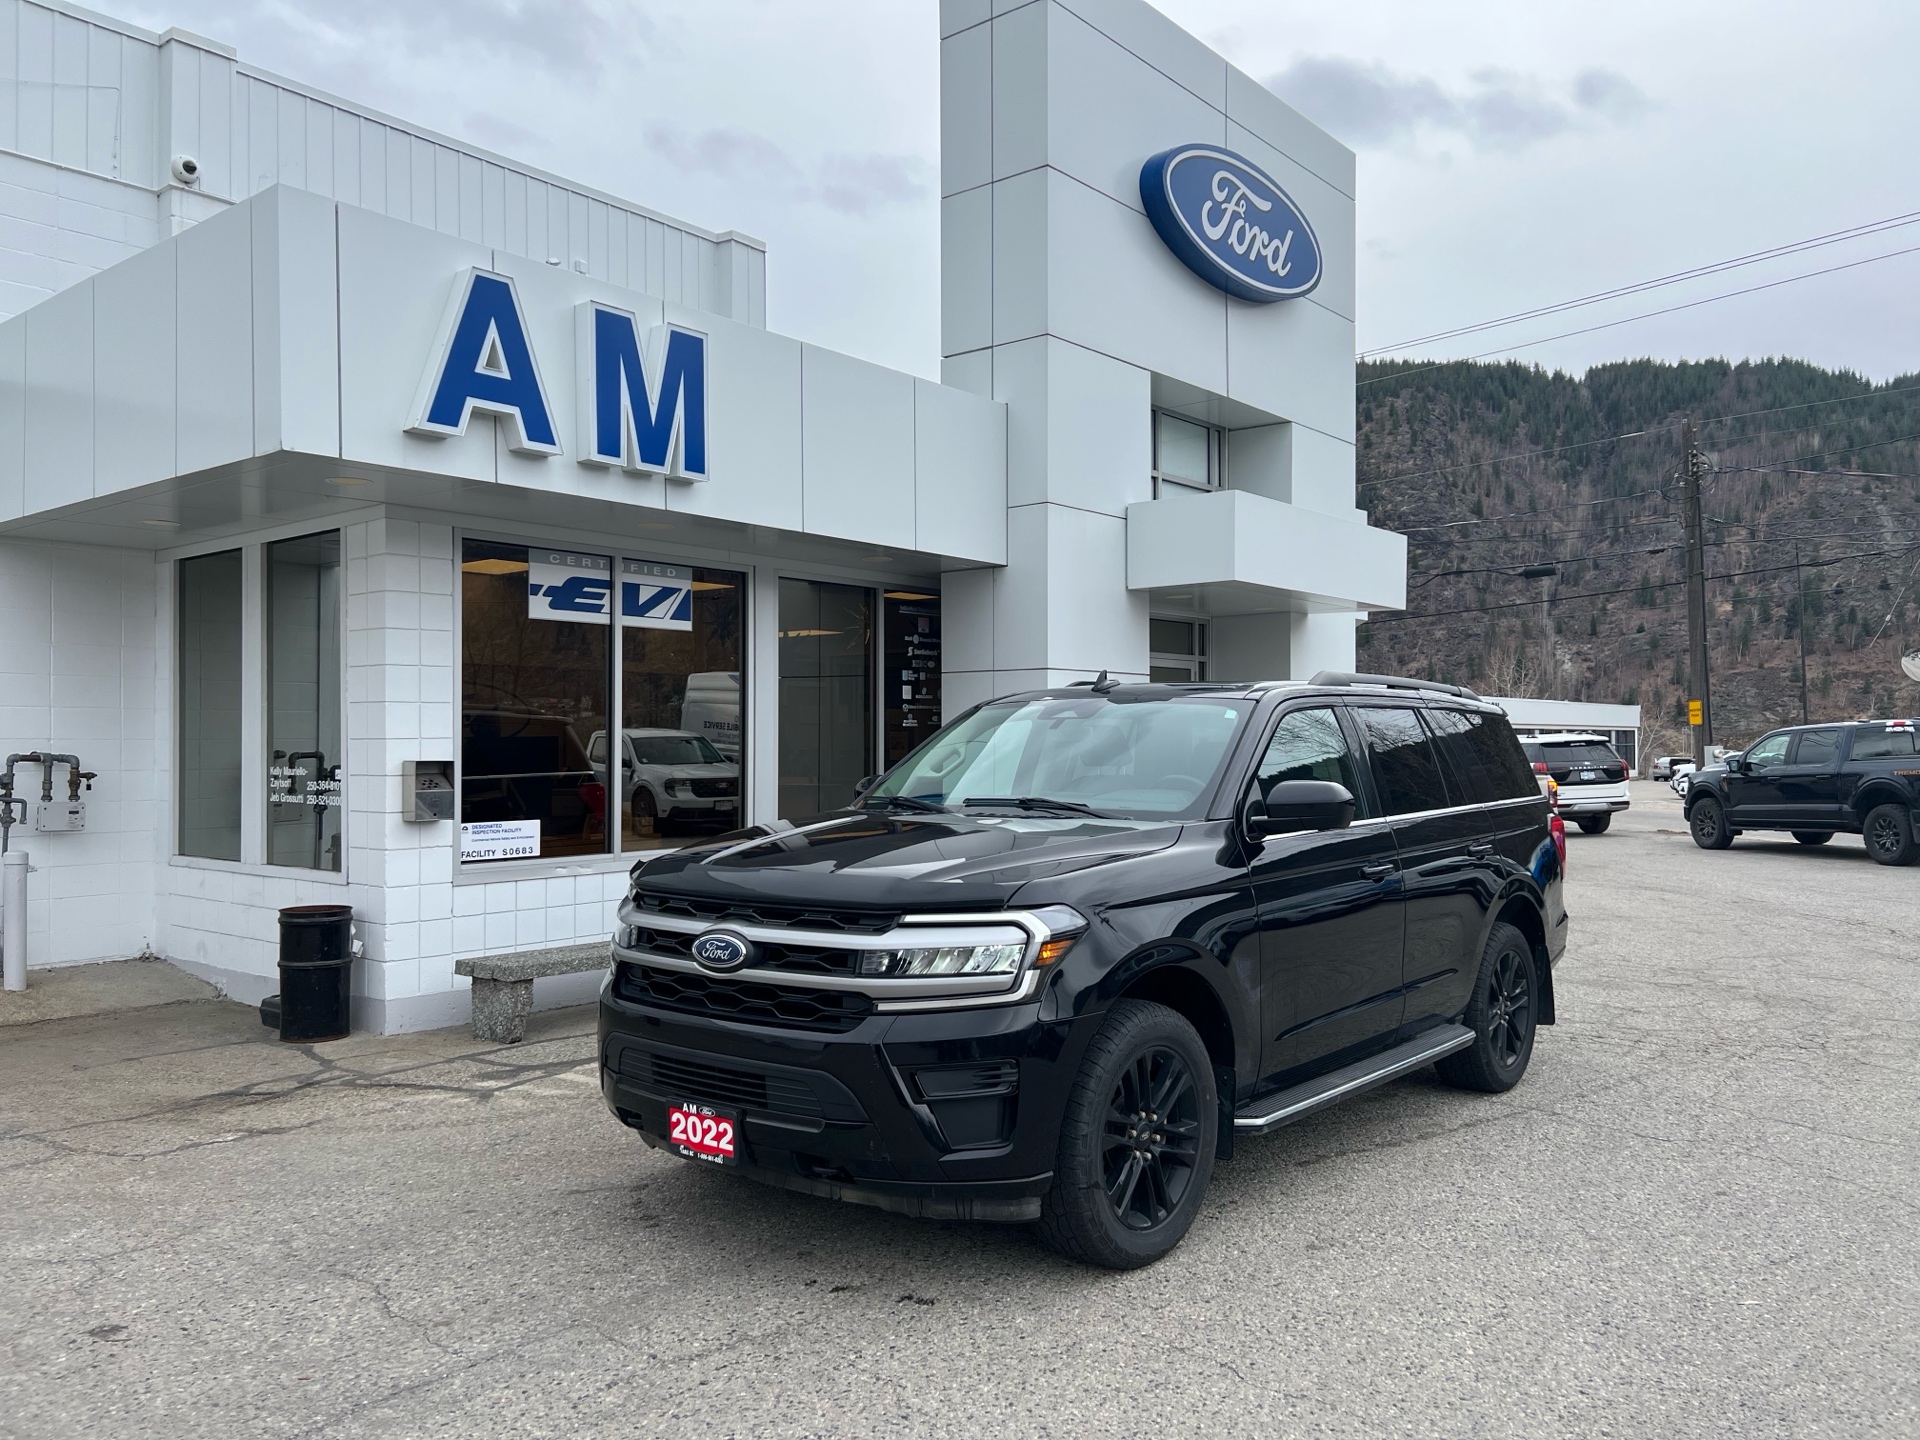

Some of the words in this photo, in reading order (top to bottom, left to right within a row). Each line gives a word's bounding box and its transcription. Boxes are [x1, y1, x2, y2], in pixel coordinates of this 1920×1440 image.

[1201, 170, 1294, 277] Ford
[416, 267, 709, 482] AM
[549, 553, 677, 577] CERTIFIED
[270, 766, 283, 777] Kelly
[270, 792, 280, 802] Jeb
[461, 849, 497, 859] FACILITY
[502, 846, 534, 856] S0683
[701, 940, 733, 960] Ford
[682, 1102, 697, 1115] AM
[671, 1112, 734, 1151] 2022
